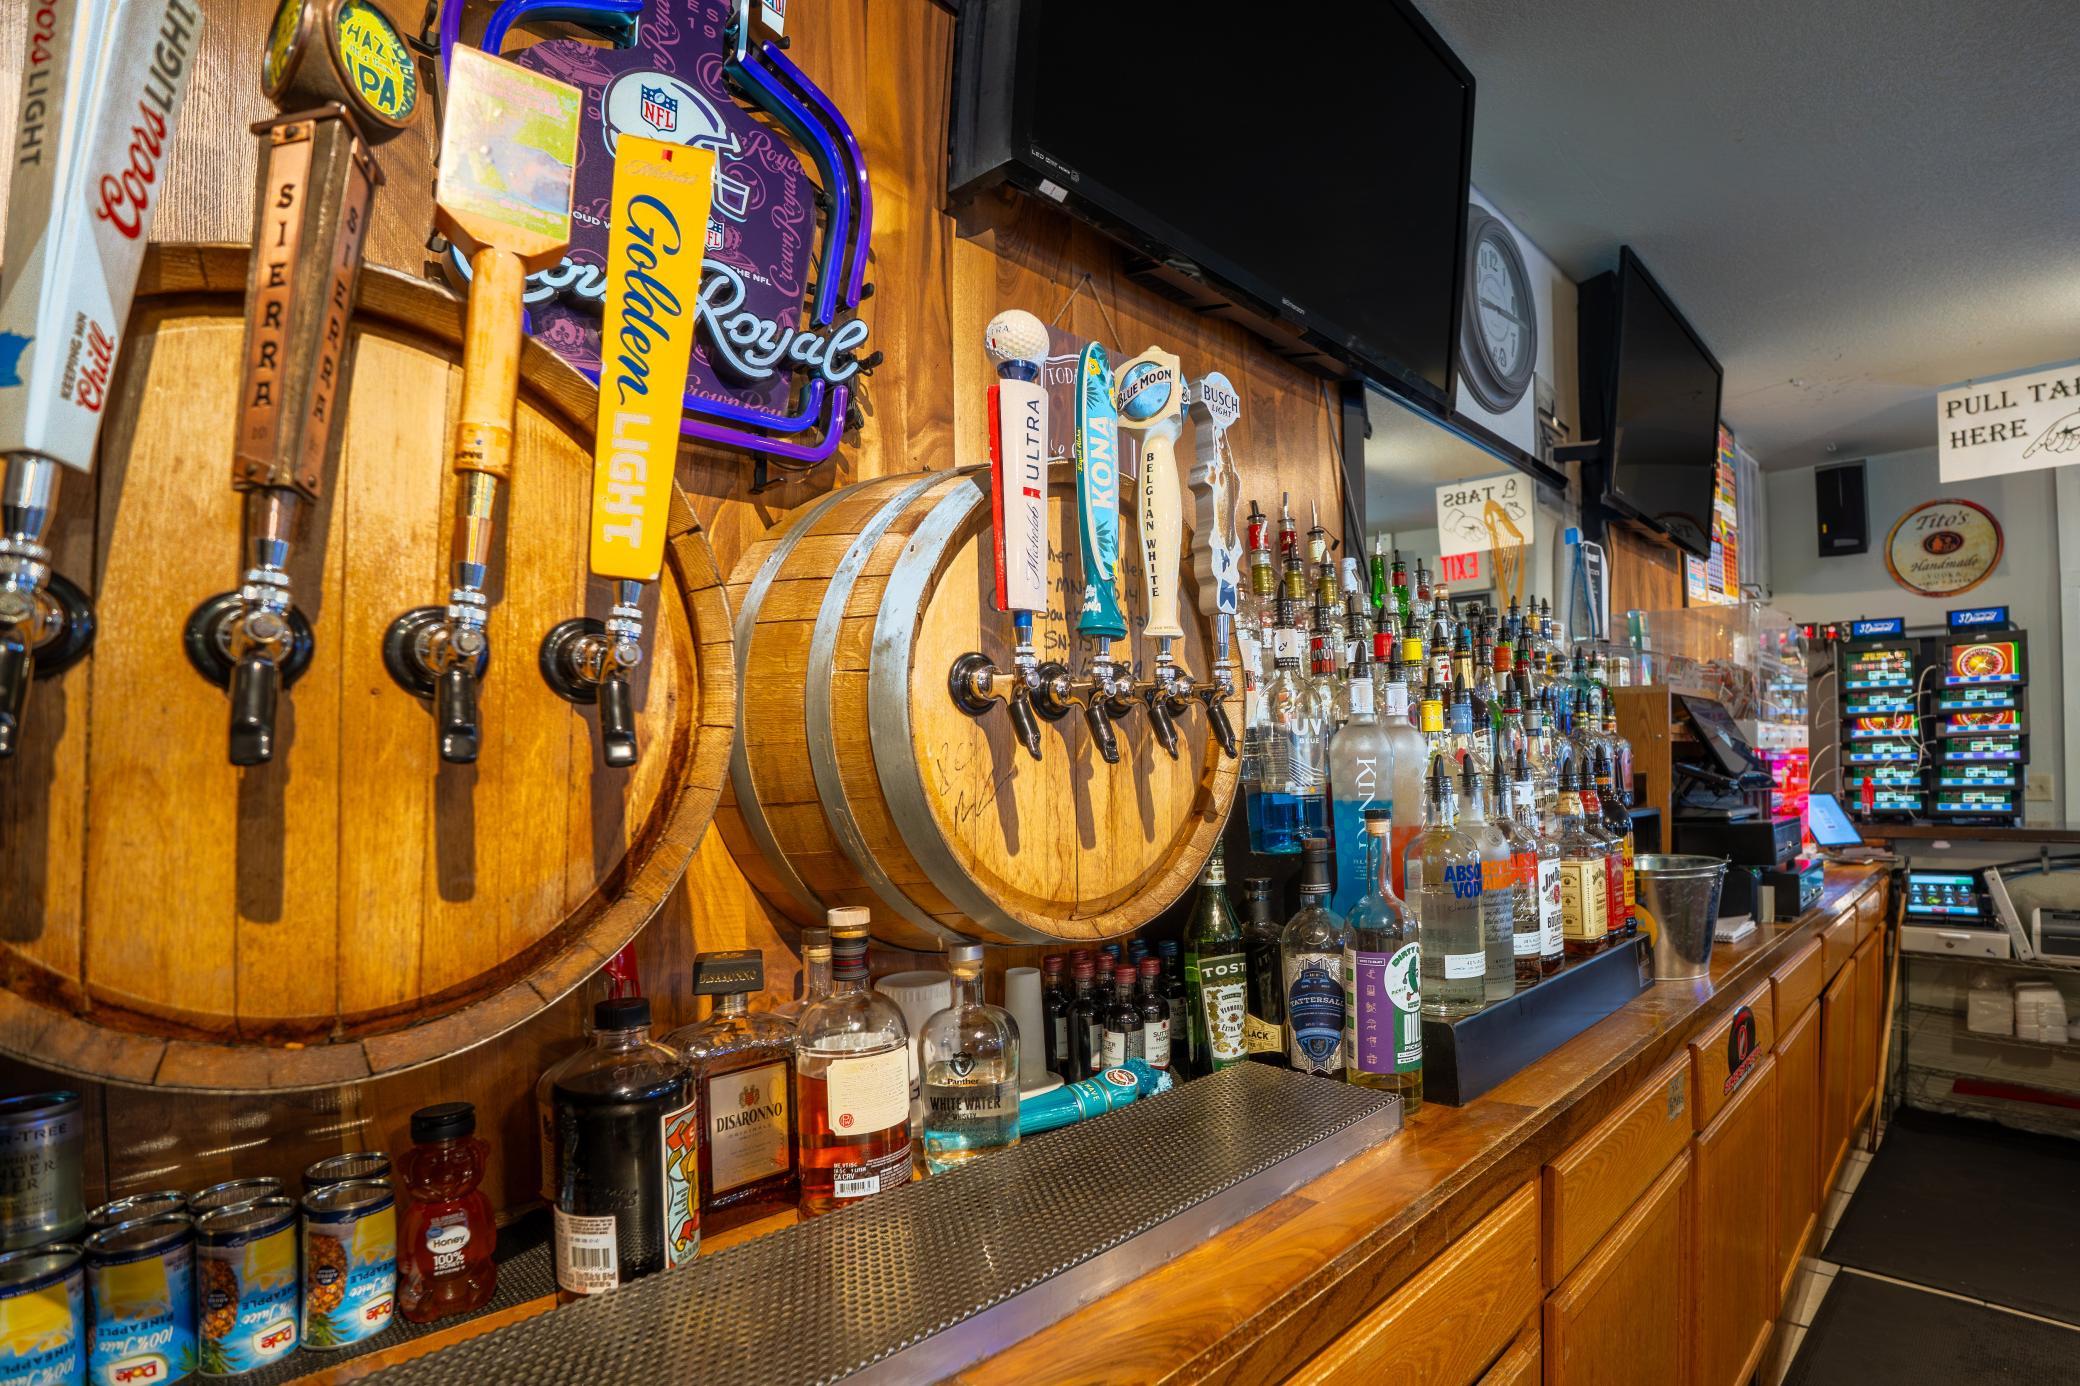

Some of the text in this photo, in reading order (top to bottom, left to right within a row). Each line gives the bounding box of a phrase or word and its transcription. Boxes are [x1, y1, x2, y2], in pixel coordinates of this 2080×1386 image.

[345, 52, 396, 110] IPA
[20, 69, 50, 167] LIGHT
[644, 101, 674, 129] NFL
[97, 100, 168, 240] Coors
[250, 183, 296, 408] SIERRA
[622, 194, 683, 405] Golden
[76, 320, 114, 413] Chill
[1117, 369, 1172, 411] BLUE MOON
[1203, 384, 1239, 413] BUSCH
[1945, 390, 2019, 419] PULL
[1211, 403, 1232, 418] LIGHT
[1026, 399, 1040, 481] ULTRA
[1950, 418, 2029, 449] HERE
[1089, 416, 1114, 510] KONA
[603, 411, 652, 549] LIGHT
[1146, 452, 1160, 598] BELGIAN WHITE
[1916, 510, 1970, 532] Tito's
[1025, 505, 1040, 591] Michelob
[1911, 554, 1979, 573] Handmade
[1292, 718, 1322, 736] UV
[1299, 736, 1320, 744] BLUE
[1444, 862, 1481, 883] ABSO
[1453, 880, 1483, 899] VOD
[716, 1102, 783, 1133] DISARONNO
[930, 1095, 1001, 1111] WHITE WATER
[432, 1235, 465, 1249] Honey
[433, 1250, 465, 1267] 100%
[98, 1313, 174, 1337] PINEAPPLE
[366, 1301, 392, 1321] Dole
[98, 1325, 174, 1357] 100% Juice
[261, 1326, 292, 1350] Dole
[39, 1354, 76, 1382] 100%
[115, 1361, 157, 1385] Dole
